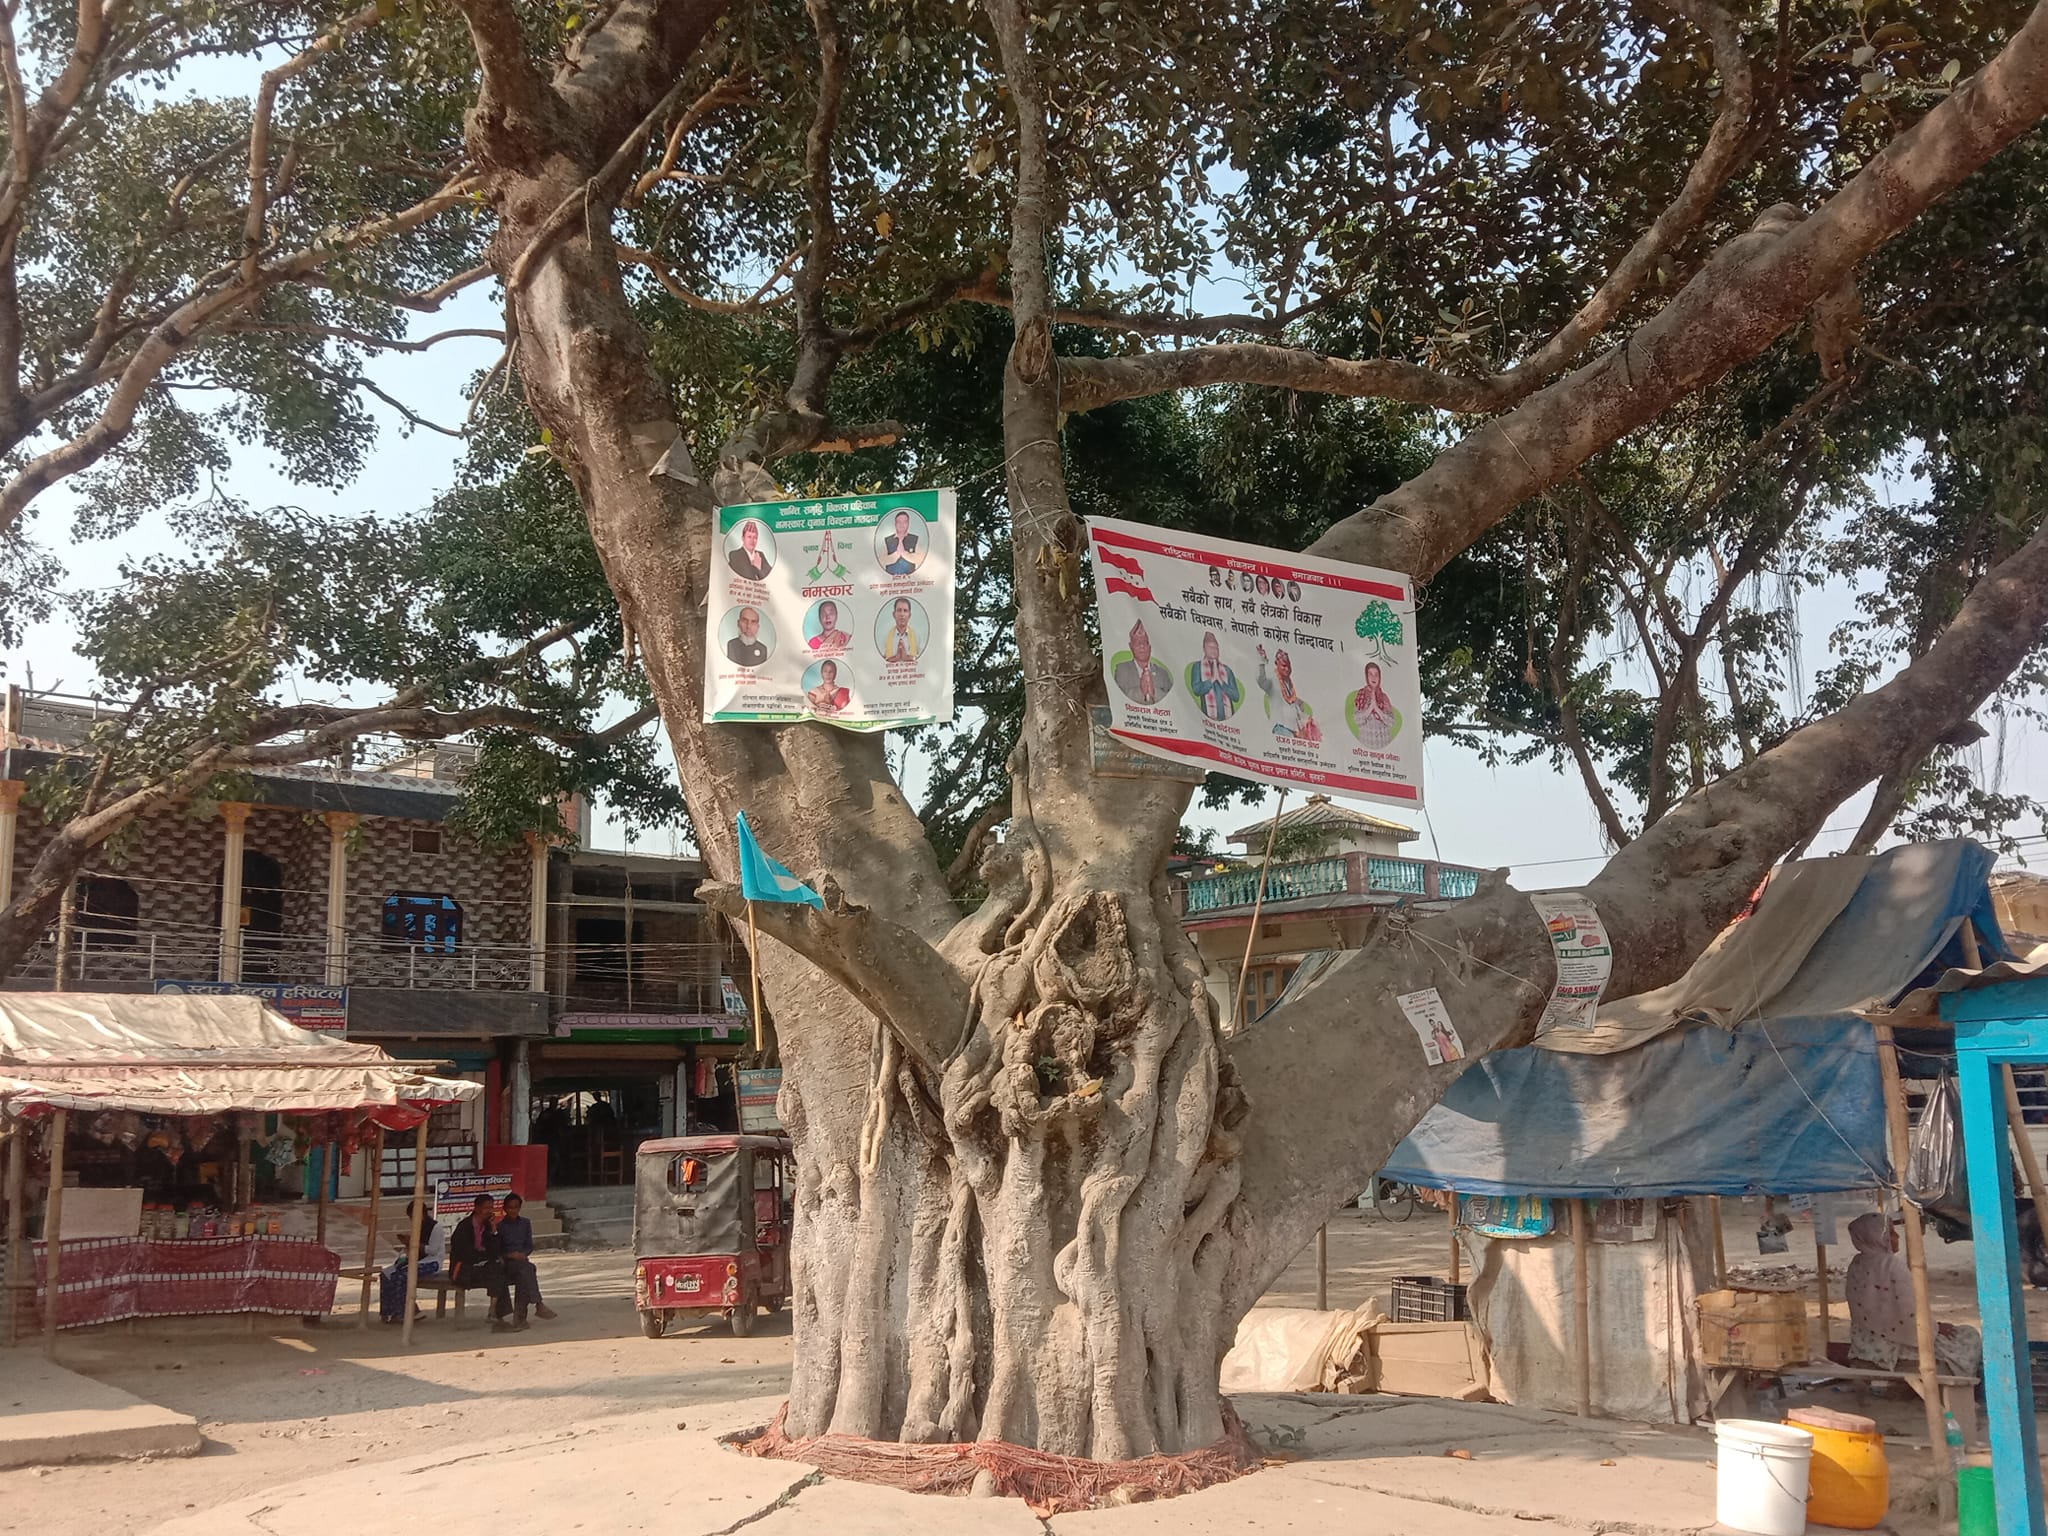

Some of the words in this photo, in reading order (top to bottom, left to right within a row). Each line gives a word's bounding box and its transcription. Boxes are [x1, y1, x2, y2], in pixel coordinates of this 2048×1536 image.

[802, 584, 854, 598] नमस्कार
[1294, 606, 1323, 627] विकास
[1230, 618, 1259, 637] नेपाली
